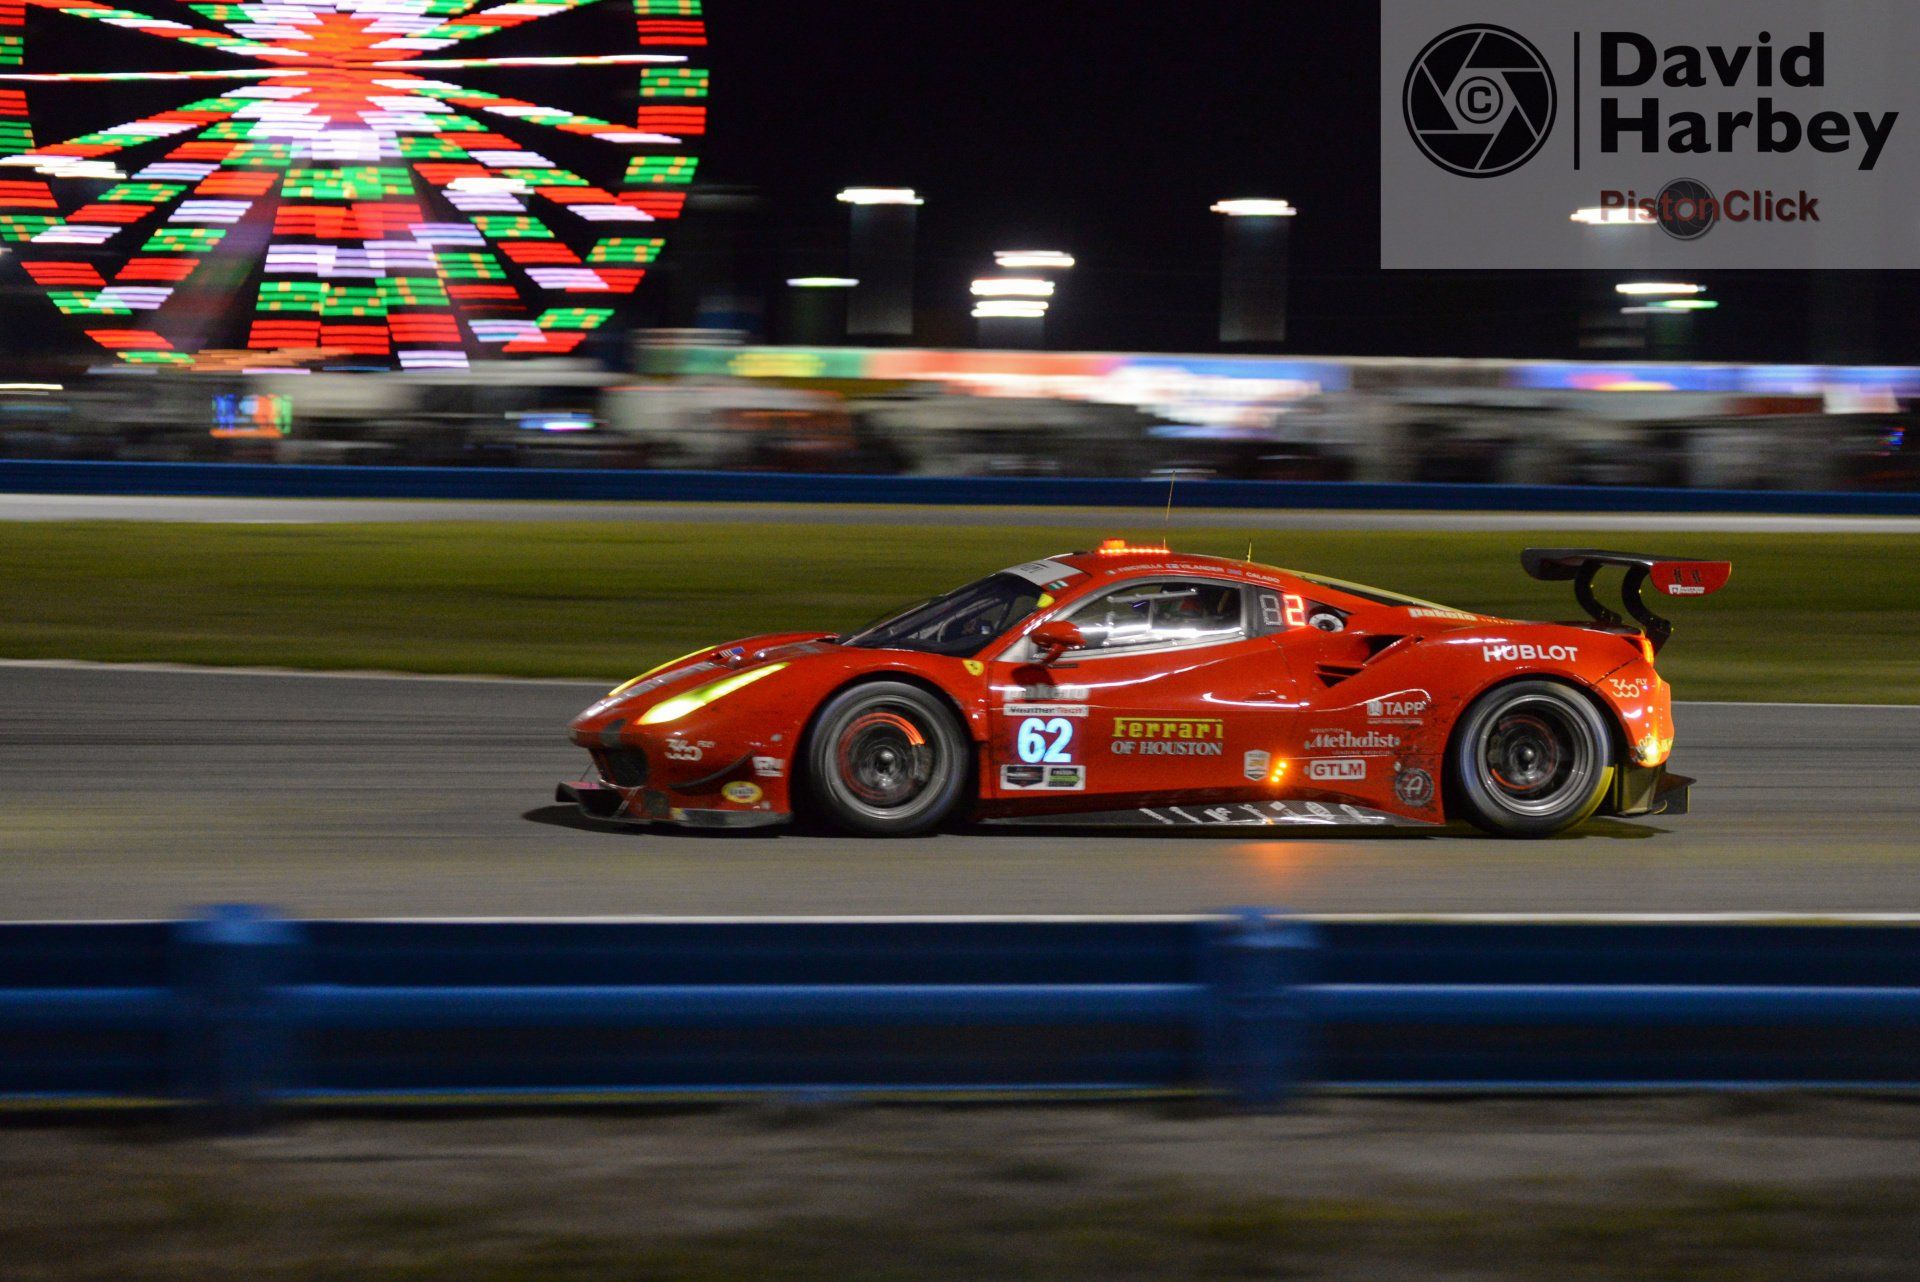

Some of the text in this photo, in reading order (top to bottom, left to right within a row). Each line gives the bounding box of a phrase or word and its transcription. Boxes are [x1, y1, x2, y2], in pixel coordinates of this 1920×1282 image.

[1482, 643, 1578, 663] HUBLOT
[1609, 678, 1640, 698] 360
[1383, 701, 1424, 716] TAPP
[1112, 717, 1224, 739] Ferrari
[1017, 717, 1074, 764] 62
[1111, 741, 1223, 756] OF HOUSTON
[1310, 731, 1395, 748] Methodist
[1314, 763, 1363, 777] GTLM
